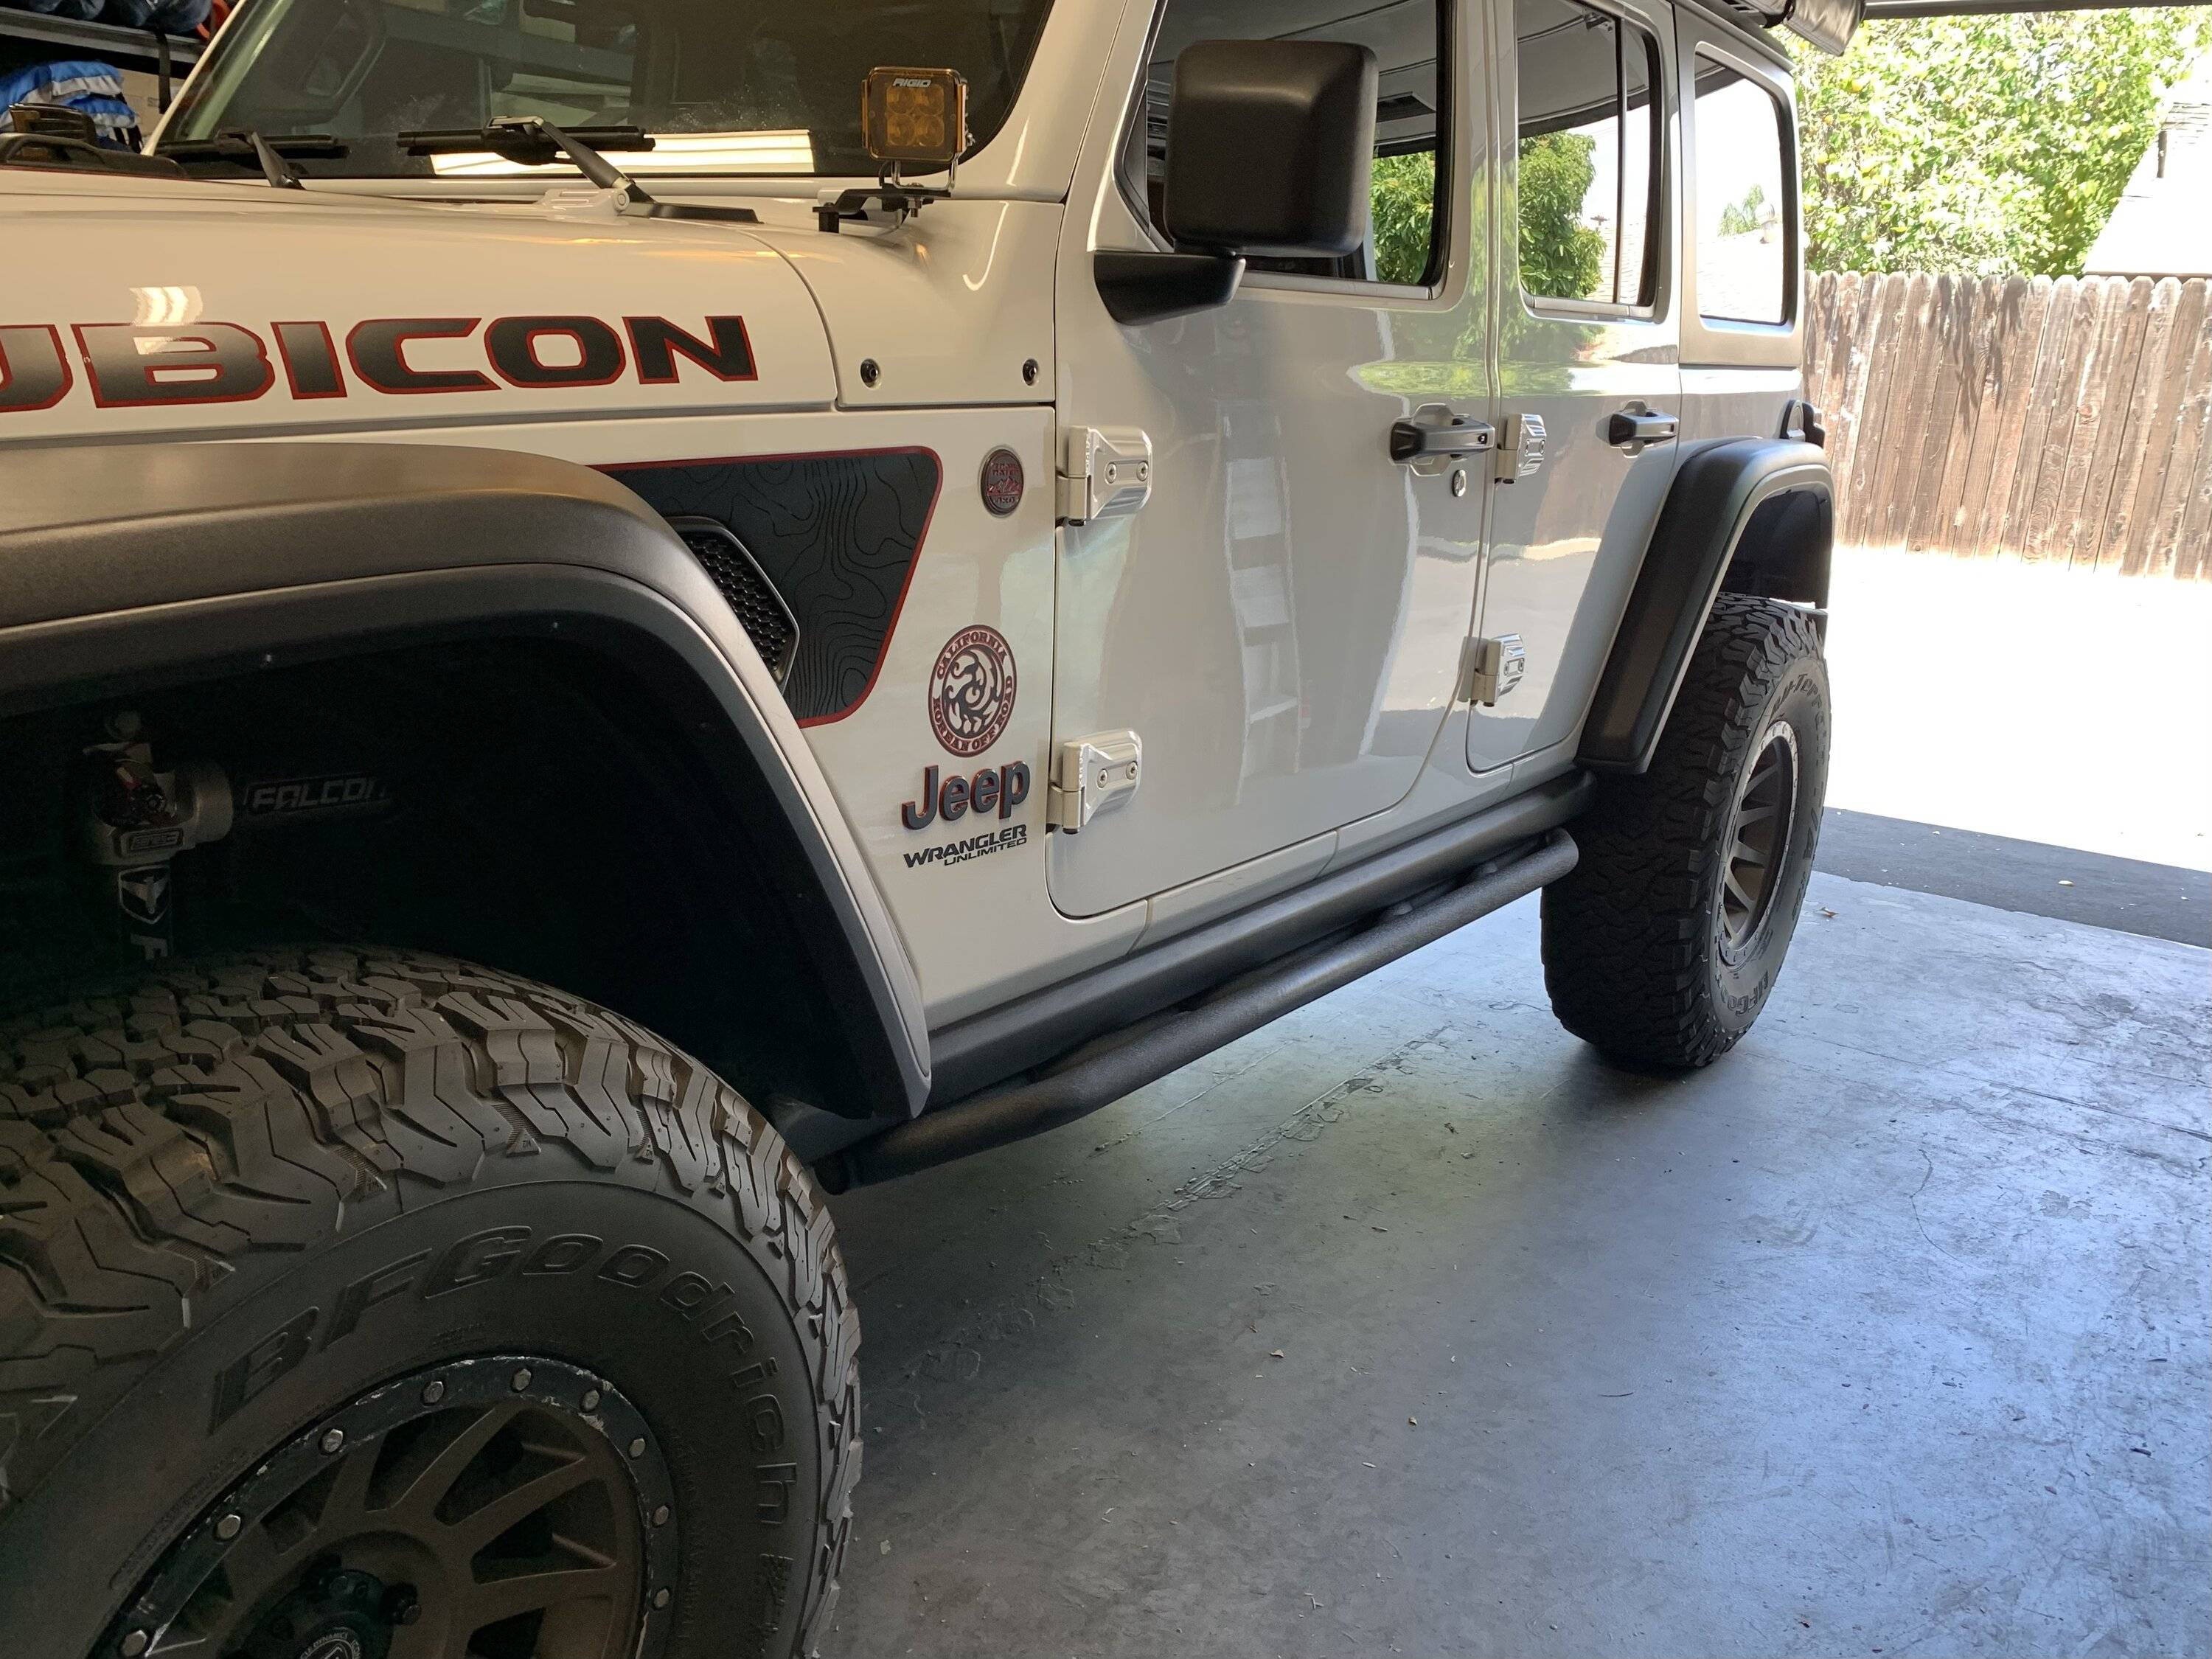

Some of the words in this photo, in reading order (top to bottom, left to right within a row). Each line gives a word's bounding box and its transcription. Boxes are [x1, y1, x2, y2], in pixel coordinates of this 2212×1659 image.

[892, 78, 931, 88] RIGID
[937, 631, 1008, 679] CALIFORNIA
[902, 760, 1030, 830] Jeep
[903, 824, 1026, 868] WRANGLER
[945, 838, 1026, 866] UNLIMITED
[209, 1225, 797, 1525] BFGoodrich
